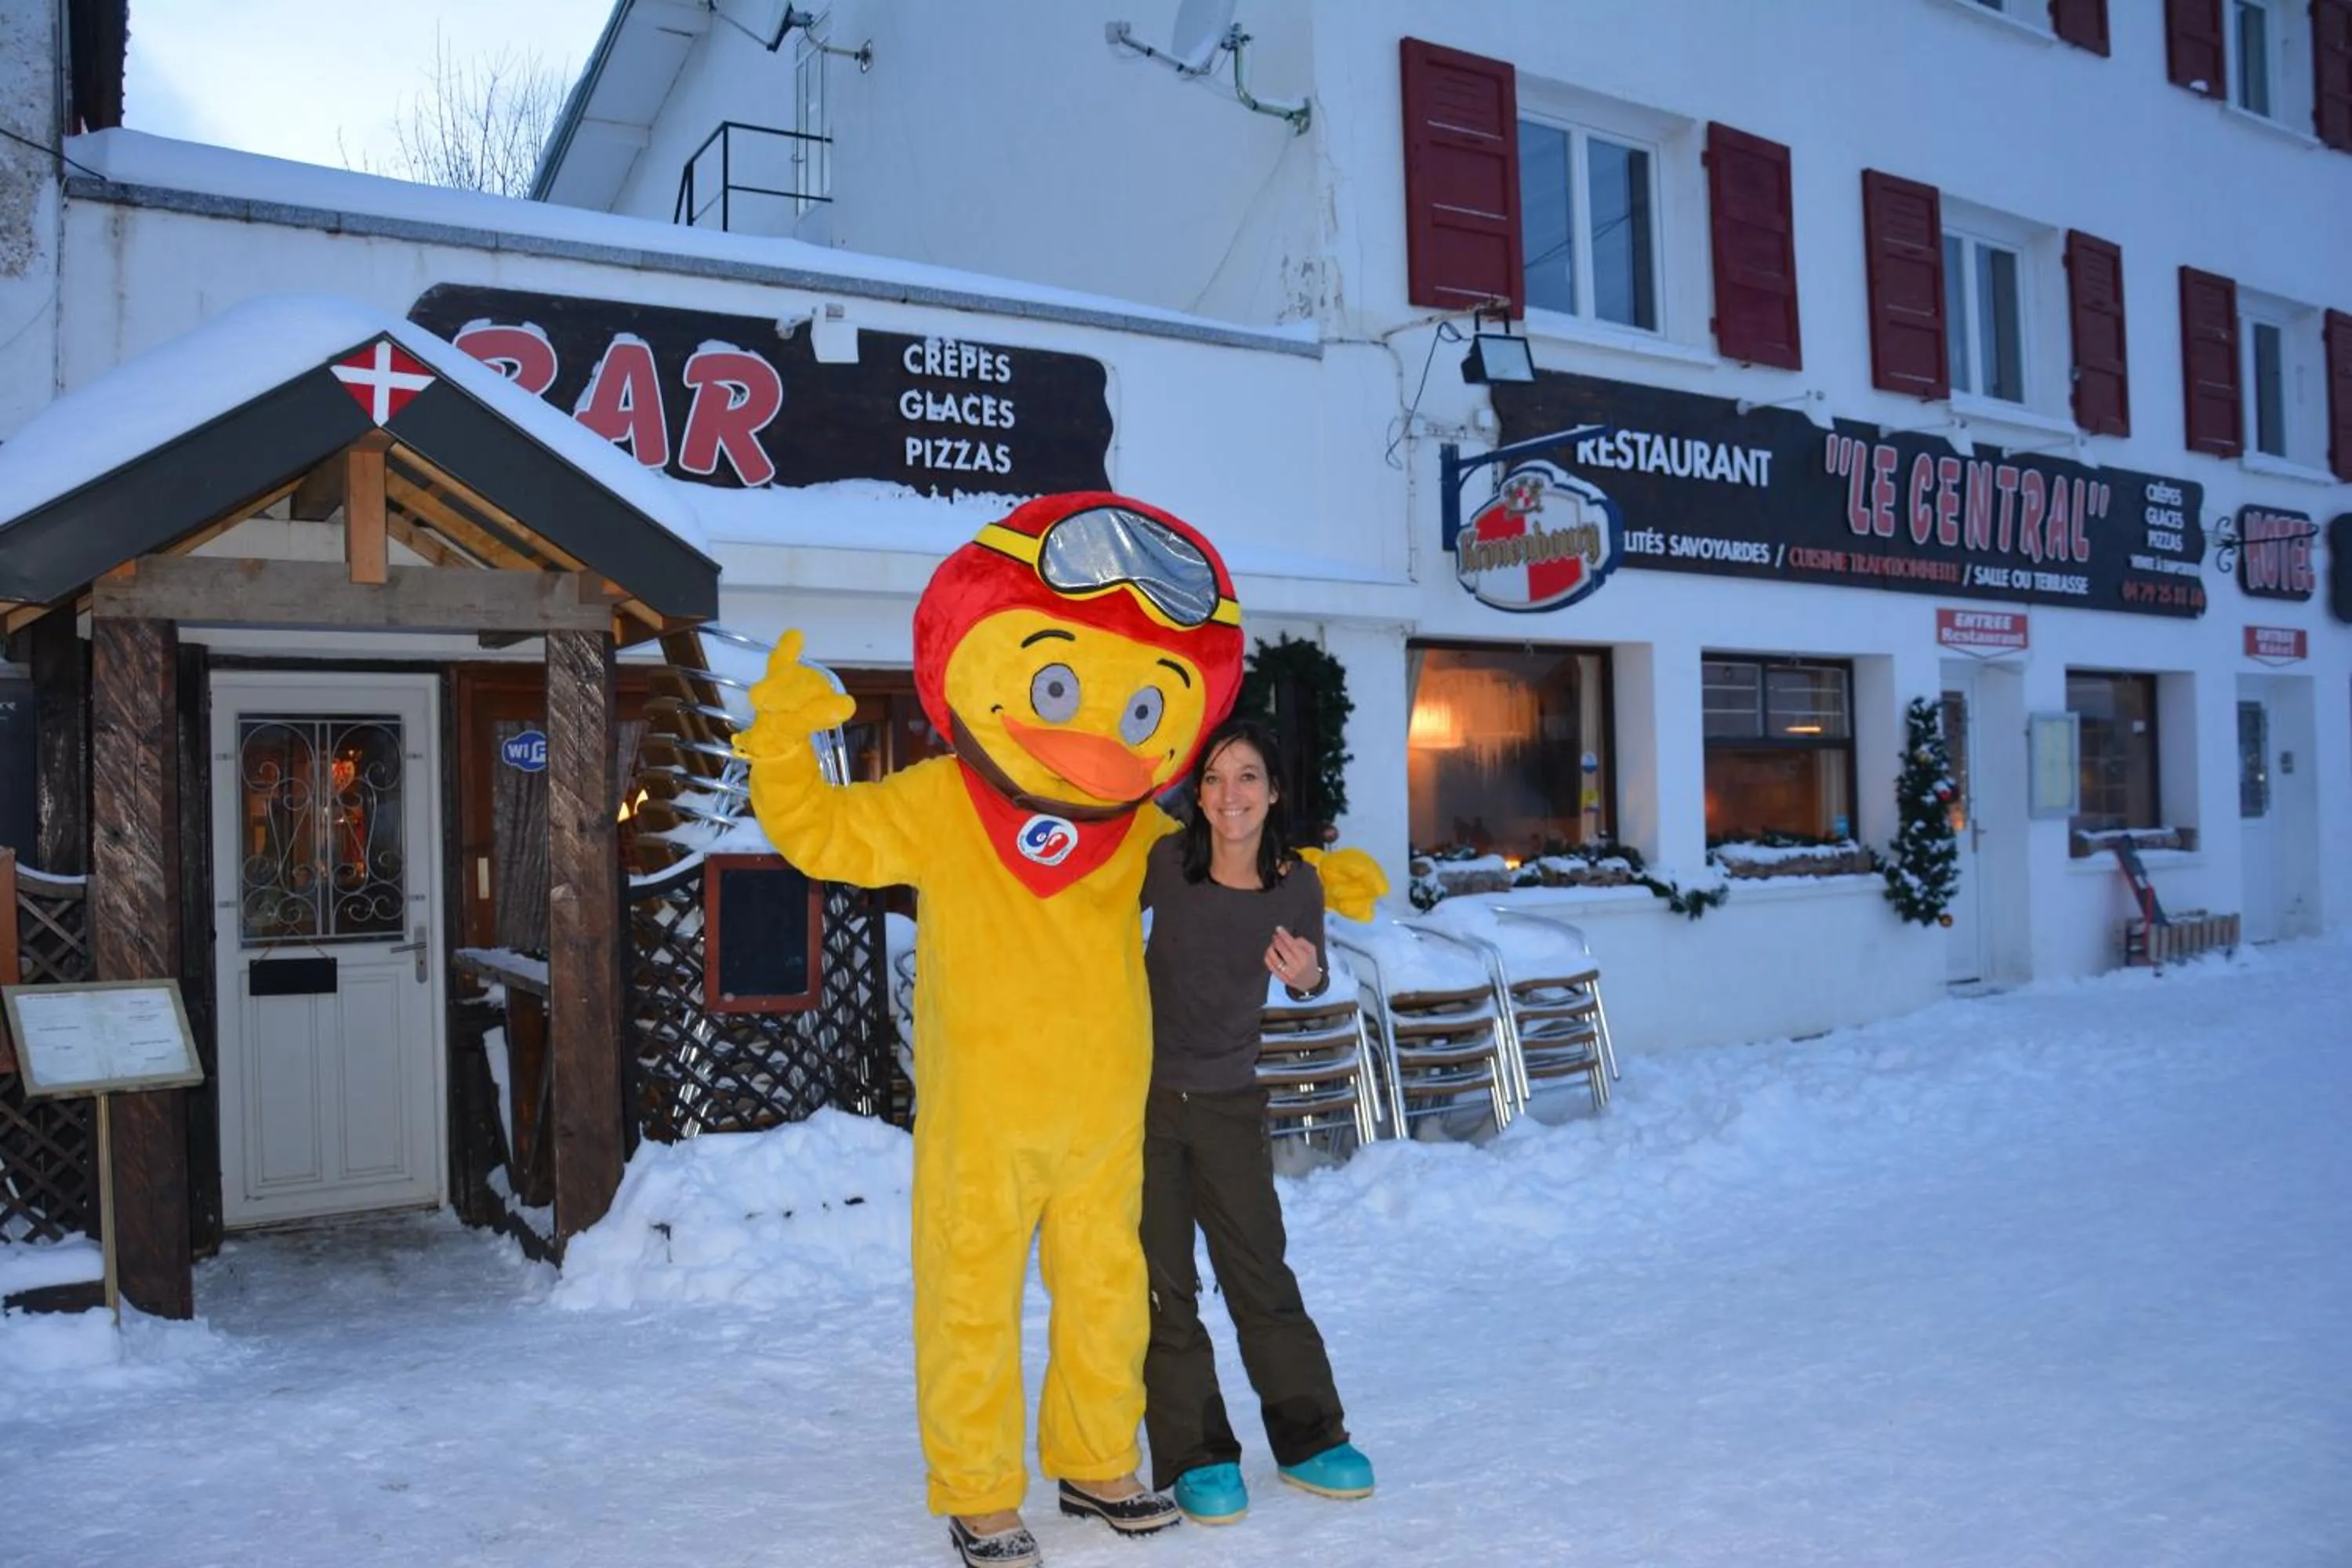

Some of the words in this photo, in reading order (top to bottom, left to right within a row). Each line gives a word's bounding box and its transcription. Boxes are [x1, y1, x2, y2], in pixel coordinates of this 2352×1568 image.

[903, 339, 1011, 383] CRÊPES
[899, 389, 1016, 430] GLACES
[905, 436, 1012, 474] PIZZAS
[1577, 429, 1773, 487] RESTAURANT
[2144, 506, 2184, 530] GLACES
[1458, 521, 1600, 575] Kronenbourg
[1624, 526, 1665, 555] LITÉS
[1669, 535, 1771, 564] SAVOYARDES
[1788, 546, 1847, 572] CUISINE
[1974, 566, 2009, 587] SALLE
[2011, 570, 2031, 590] OU
[2033, 573, 2089, 595] TERRASSE
[2147, 530, 2183, 552] PIZZAS
[1942, 626, 2025, 645] Restaurant
